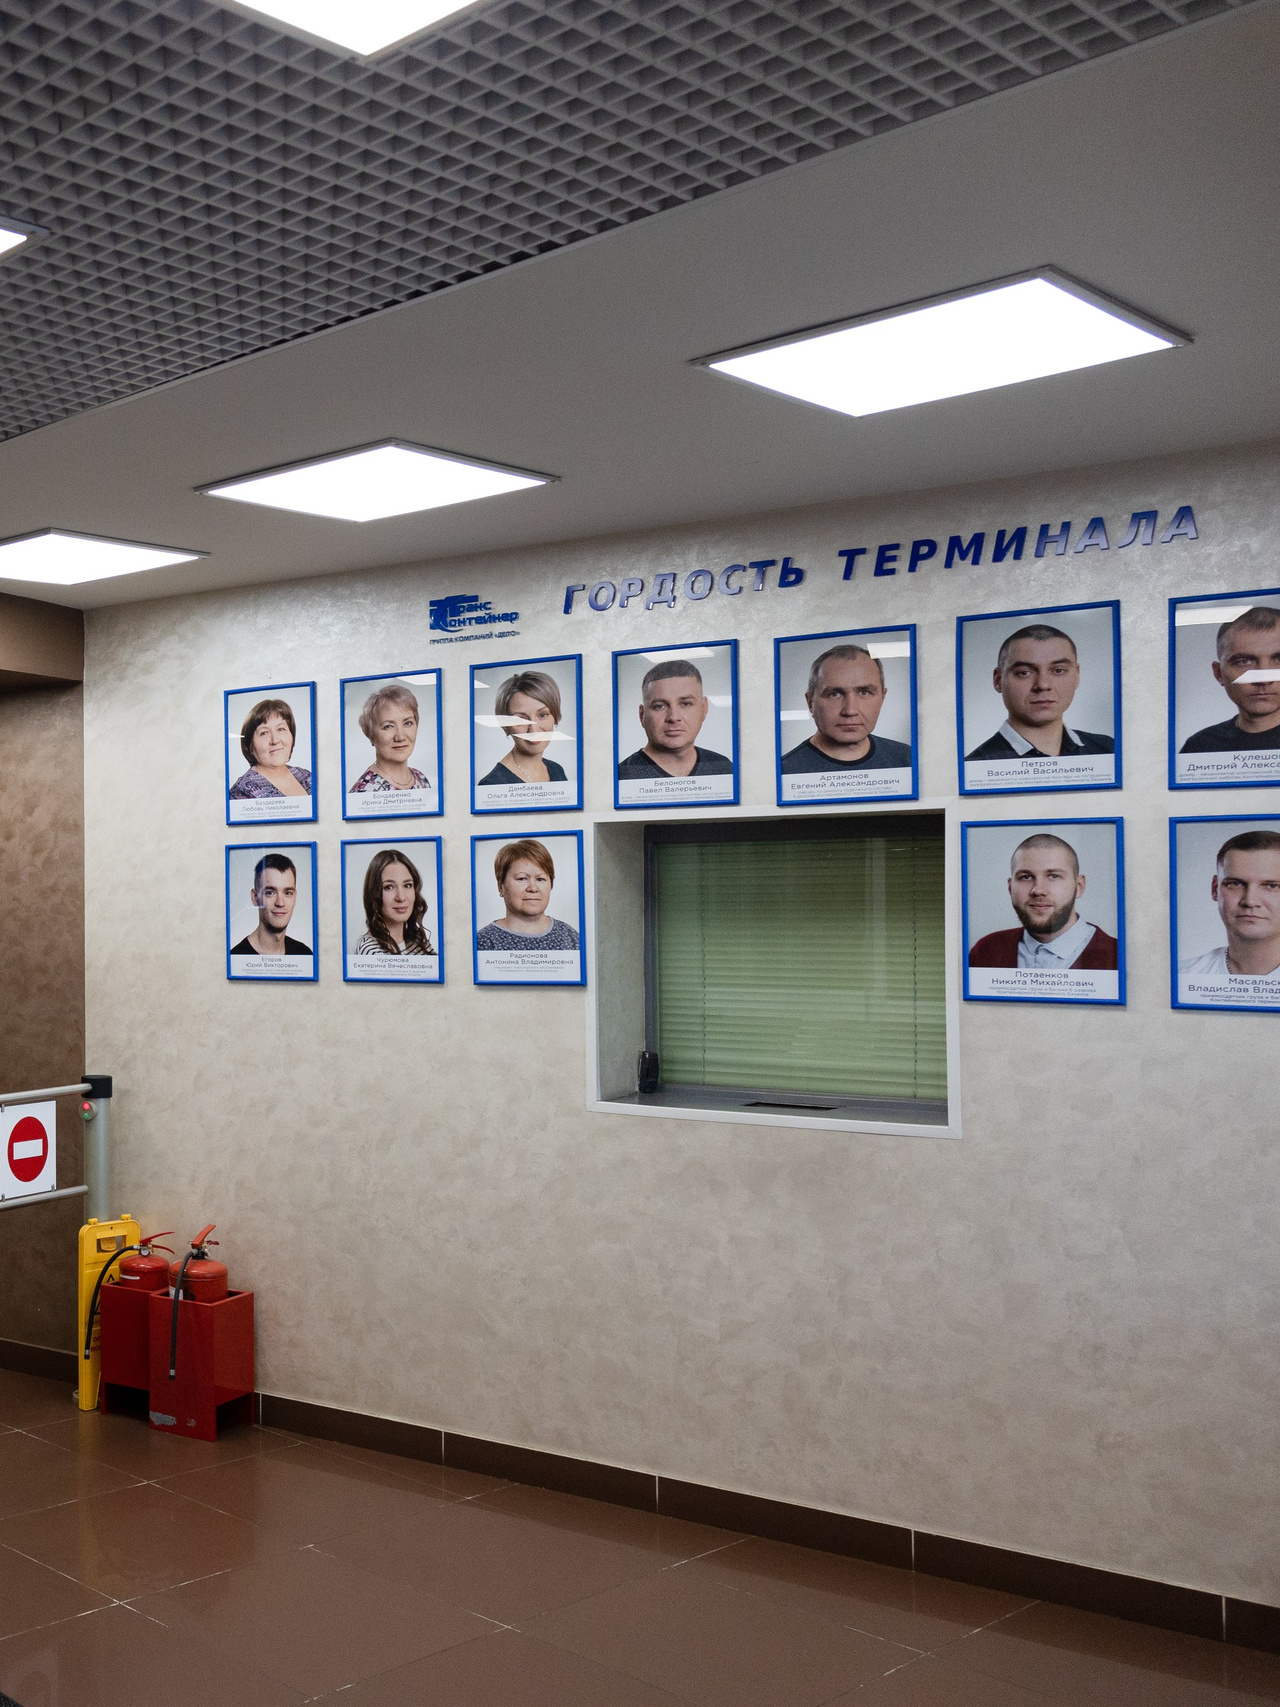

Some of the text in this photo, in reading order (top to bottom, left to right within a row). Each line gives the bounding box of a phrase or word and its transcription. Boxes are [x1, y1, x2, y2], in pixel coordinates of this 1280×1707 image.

[563, 505, 1201, 615] ГОРДОСТЬ ТЕРМИНАЛА
[429, 637, 454, 645] ГРУППА
[1233, 753, 1280, 762] Кулешо
[1033, 767, 1094, 775] Васильевич
[1187, 763, 1238, 772] Дмитрий
[820, 773, 869, 781] Артамонов
[790, 779, 900, 790] Евгений Александрович
[507, 785, 543, 793] Дамбаева
[665, 785, 712, 793] Валерьевич
[372, 792, 412, 800] Бондаренко
[509, 790, 565, 798] Александровна
[520, 958, 574, 966] Владимировна
[1015, 971, 1069, 979] Потаенков
[991, 978, 1094, 987] Никита Михайлович
[1188, 984, 1249, 993] Владислав
